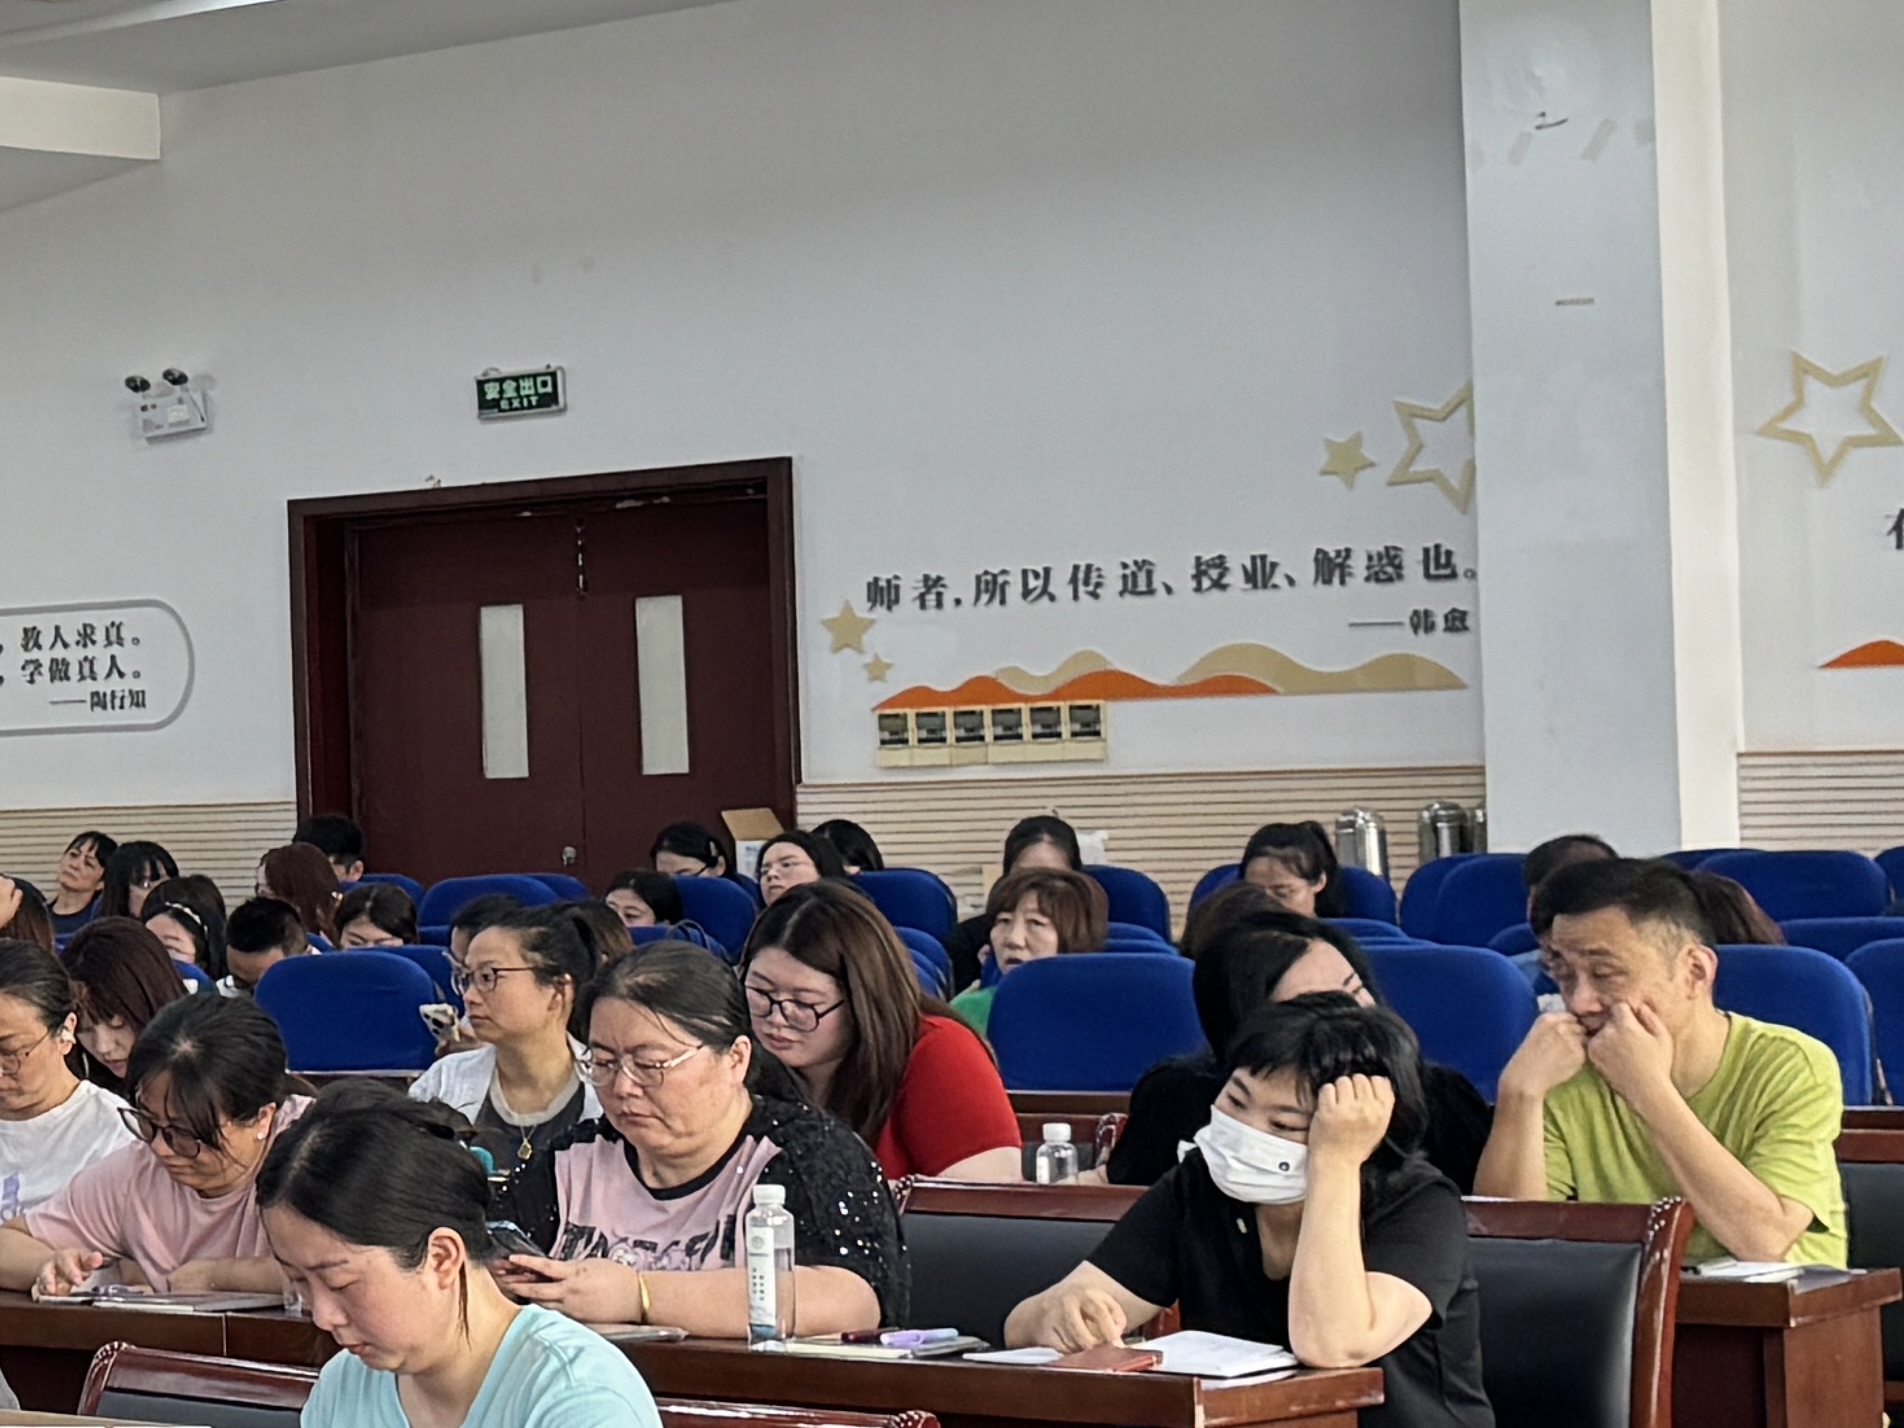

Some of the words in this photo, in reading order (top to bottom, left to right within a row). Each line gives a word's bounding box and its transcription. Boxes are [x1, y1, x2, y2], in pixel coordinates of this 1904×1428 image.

[484, 375, 553, 400] 安全出口
[500, 395, 538, 409] EXIT
